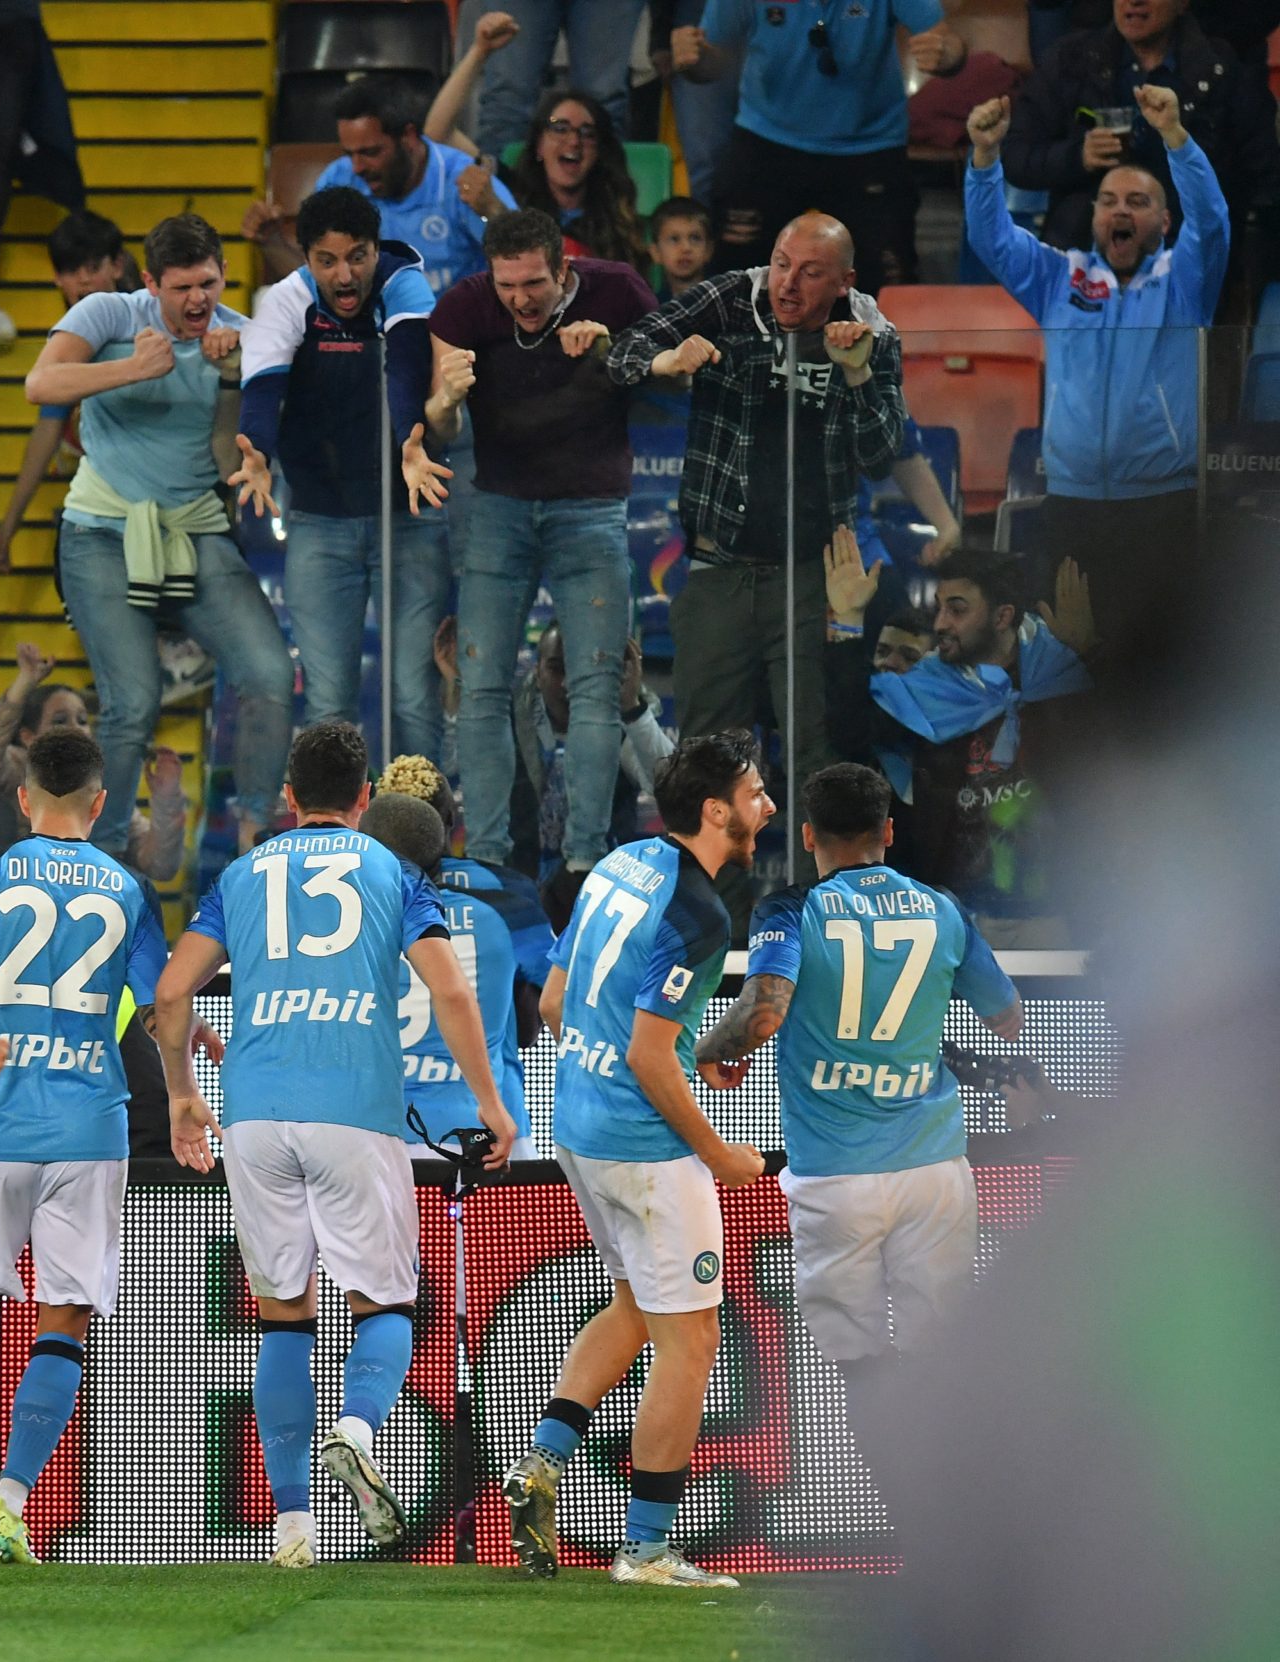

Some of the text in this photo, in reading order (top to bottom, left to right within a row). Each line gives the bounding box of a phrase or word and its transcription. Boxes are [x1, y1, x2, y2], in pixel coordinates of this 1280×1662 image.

[8, 857, 123, 892] DI LORENZO
[252, 852, 363, 960] 13
[822, 889, 936, 916] M. OLIVERA
[859, 873, 887, 887] SSCN
[564, 871, 649, 1008] 77
[825, 919, 938, 1041] 17
